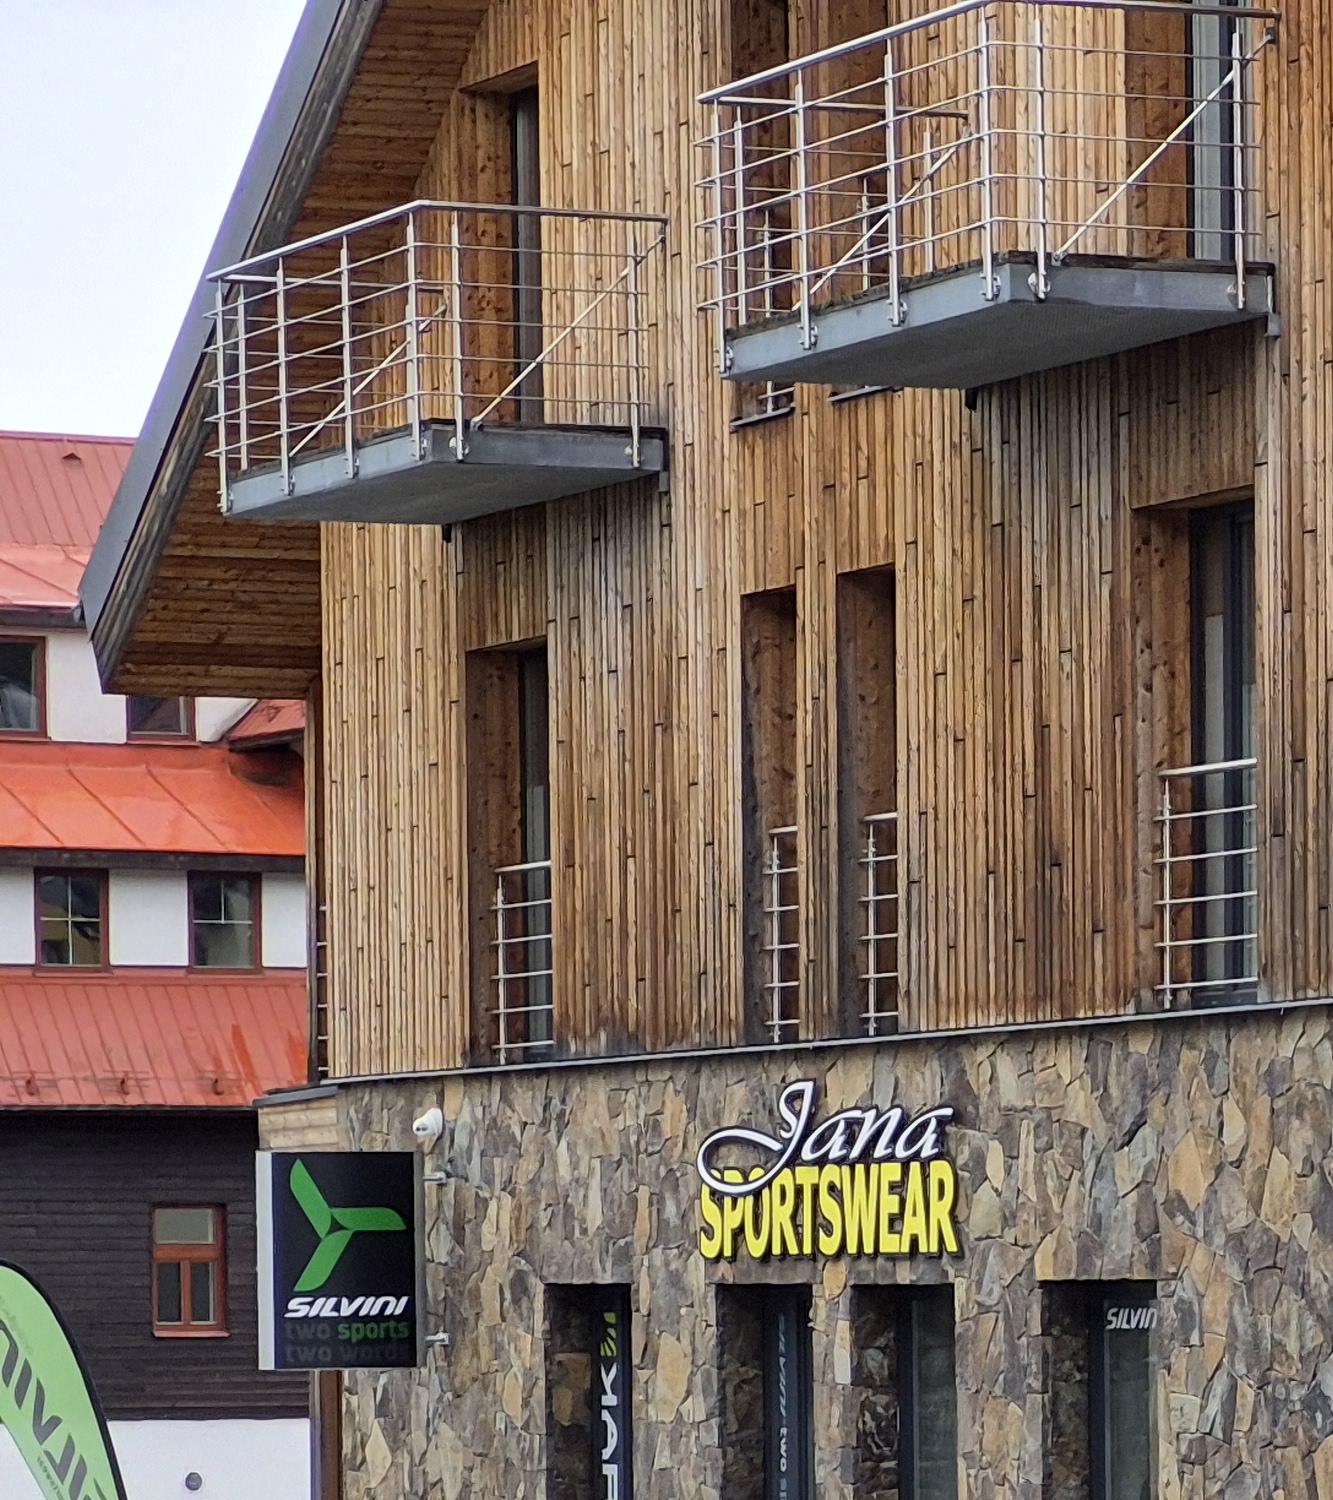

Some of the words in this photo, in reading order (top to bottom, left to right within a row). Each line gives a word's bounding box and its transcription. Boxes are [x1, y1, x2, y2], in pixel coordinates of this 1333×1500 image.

[697, 1080, 954, 1194] Jana
[700, 1160, 958, 1259] SPORTSWEAR
[284, 1296, 409, 1318] SILVINI
[285, 1321, 331, 1340] two
[337, 1320, 409, 1343] sports
[285, 1344, 332, 1362] two
